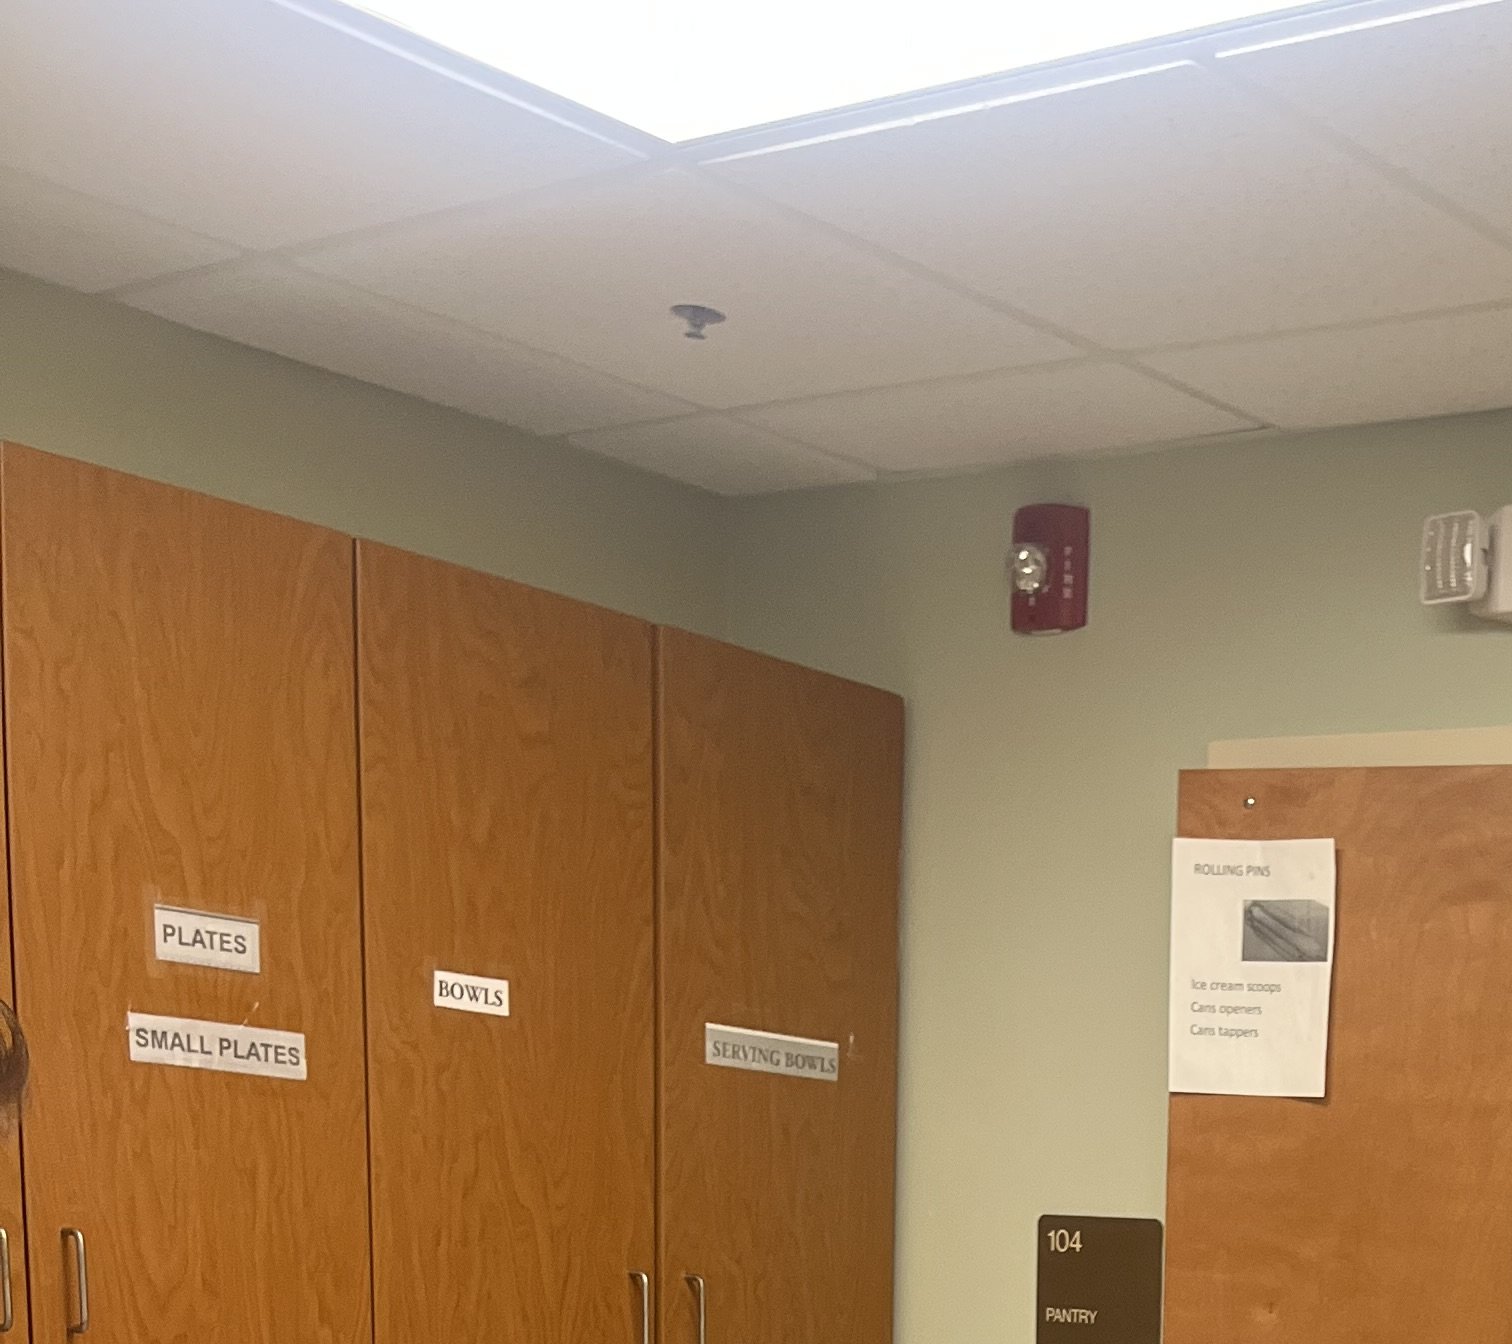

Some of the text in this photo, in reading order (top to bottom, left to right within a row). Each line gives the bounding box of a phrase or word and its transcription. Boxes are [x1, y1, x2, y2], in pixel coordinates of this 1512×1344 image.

[1193, 863, 1271, 877] ROLLING PINS
[162, 923, 247, 954] PLATES
[438, 980, 504, 1008] BOWLS
[1191, 979, 1282, 994] Ice cream scoops
[1190, 1001, 1262, 1016] Cans openers
[1190, 1024, 1259, 1039] Cans tappers
[135, 1028, 300, 1066] SMALL PLATES
[711, 1040, 837, 1074] SERVING BOWLS
[1047, 1229, 1083, 1253] 104
[1045, 1307, 1098, 1324] PANTRY
